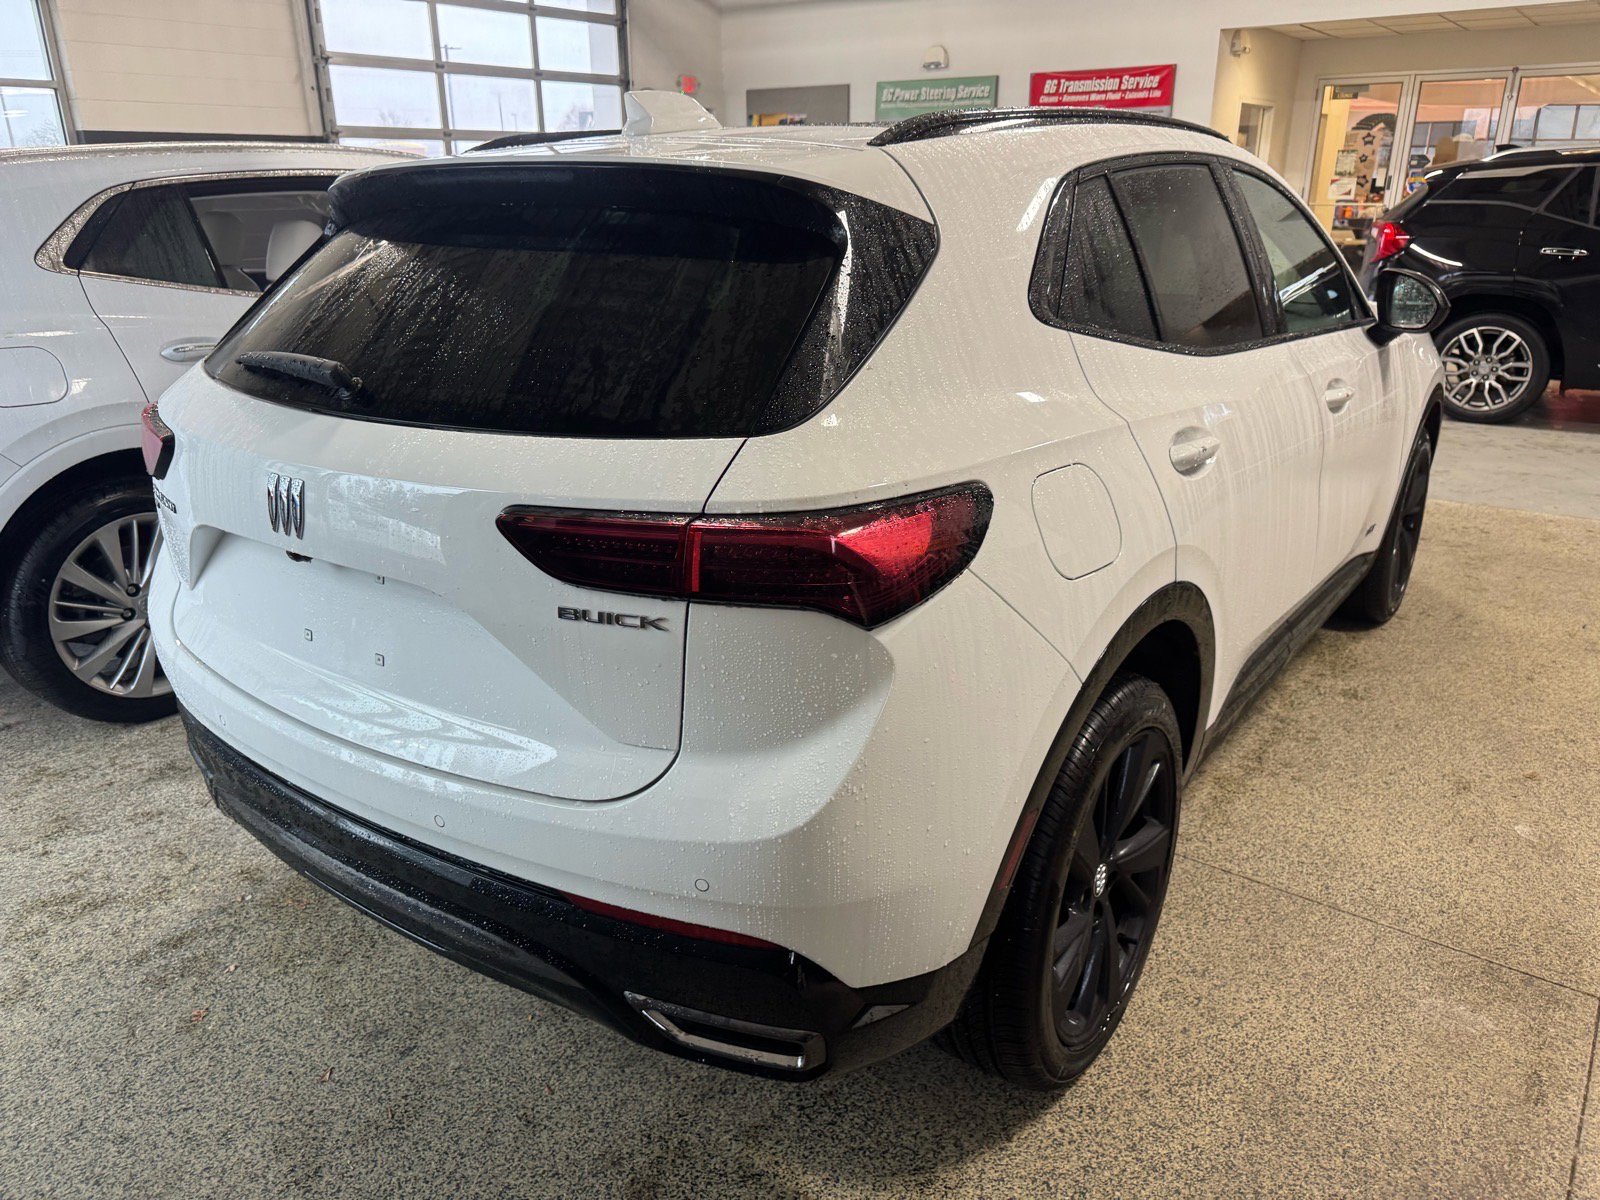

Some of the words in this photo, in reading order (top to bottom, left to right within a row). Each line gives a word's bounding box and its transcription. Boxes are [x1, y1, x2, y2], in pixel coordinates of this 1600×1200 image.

[893, 88, 919, 102] Power
[920, 86, 957, 102] Steering
[958, 84, 991, 99] Service
[1044, 79, 1057, 94] BG
[1059, 76, 1120, 94] Transmission
[1121, 73, 1160, 90] Service
[558, 606, 670, 632] BUICK
